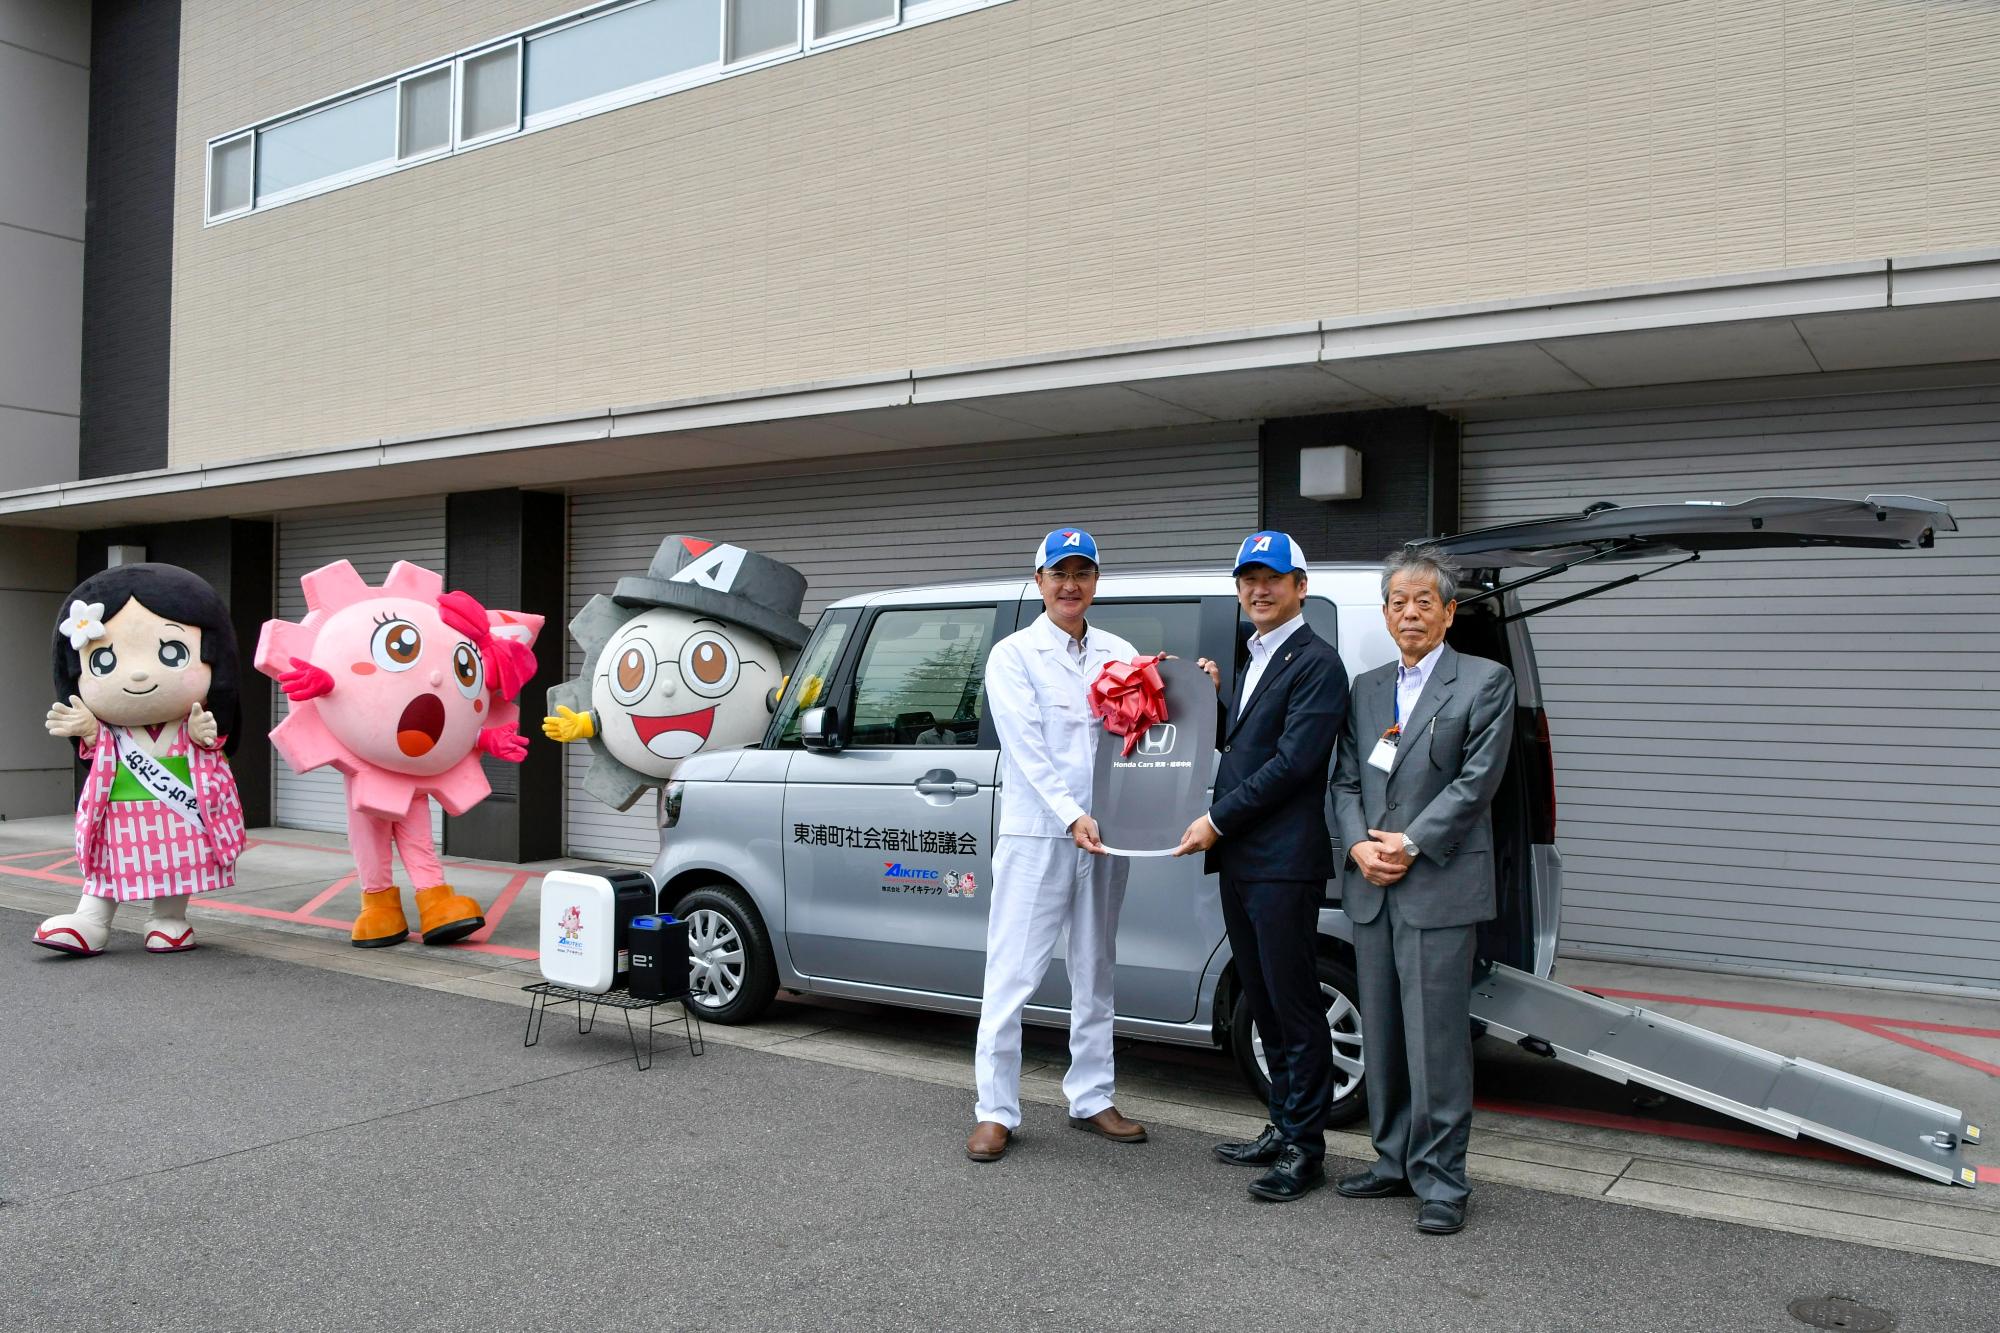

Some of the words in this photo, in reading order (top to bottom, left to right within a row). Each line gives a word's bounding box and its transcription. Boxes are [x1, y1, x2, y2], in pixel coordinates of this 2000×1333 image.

[125, 750, 206, 828] おだいちゃ
[793, 823, 977, 856] 東浦町社会福祉協議会
[883, 863, 939, 879] AIKITEC
[903, 885, 943, 895] アイキテック
